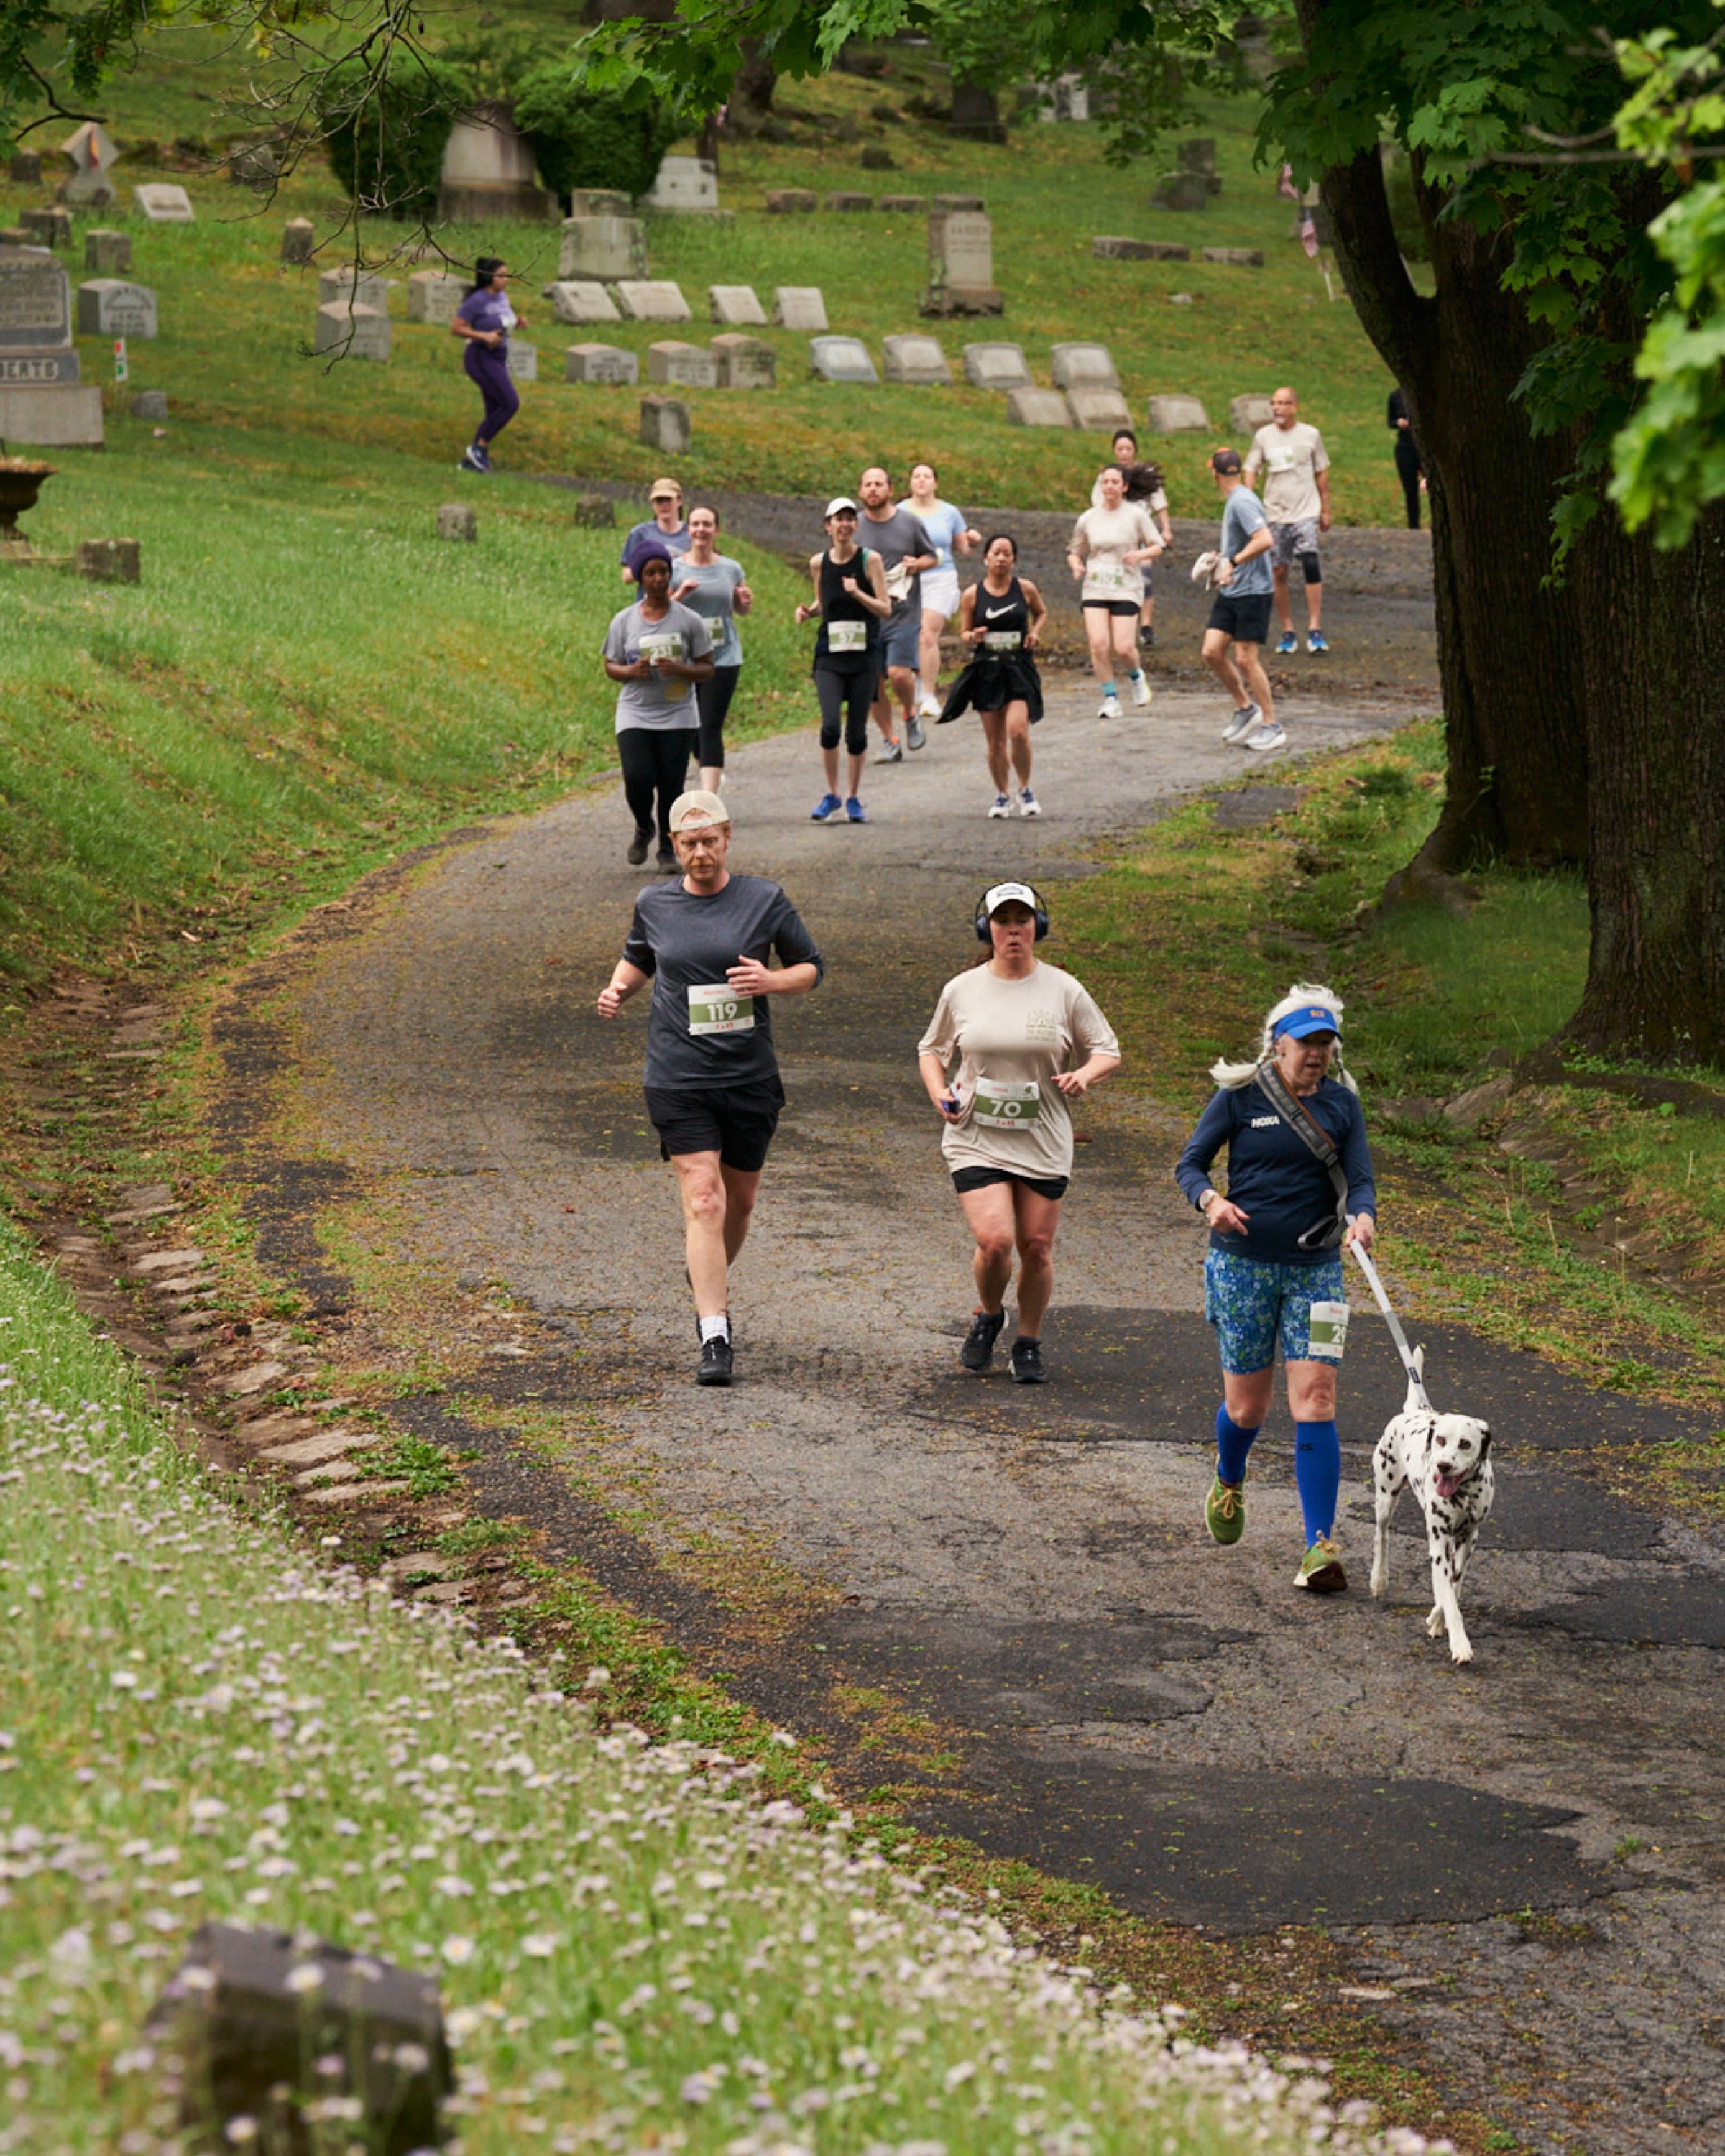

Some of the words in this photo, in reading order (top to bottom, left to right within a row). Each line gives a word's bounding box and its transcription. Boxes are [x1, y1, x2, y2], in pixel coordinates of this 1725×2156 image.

[707, 1002, 737, 1021] 119
[990, 1100, 1021, 1117] 70
[1251, 1115, 1280, 1128] HOKA
